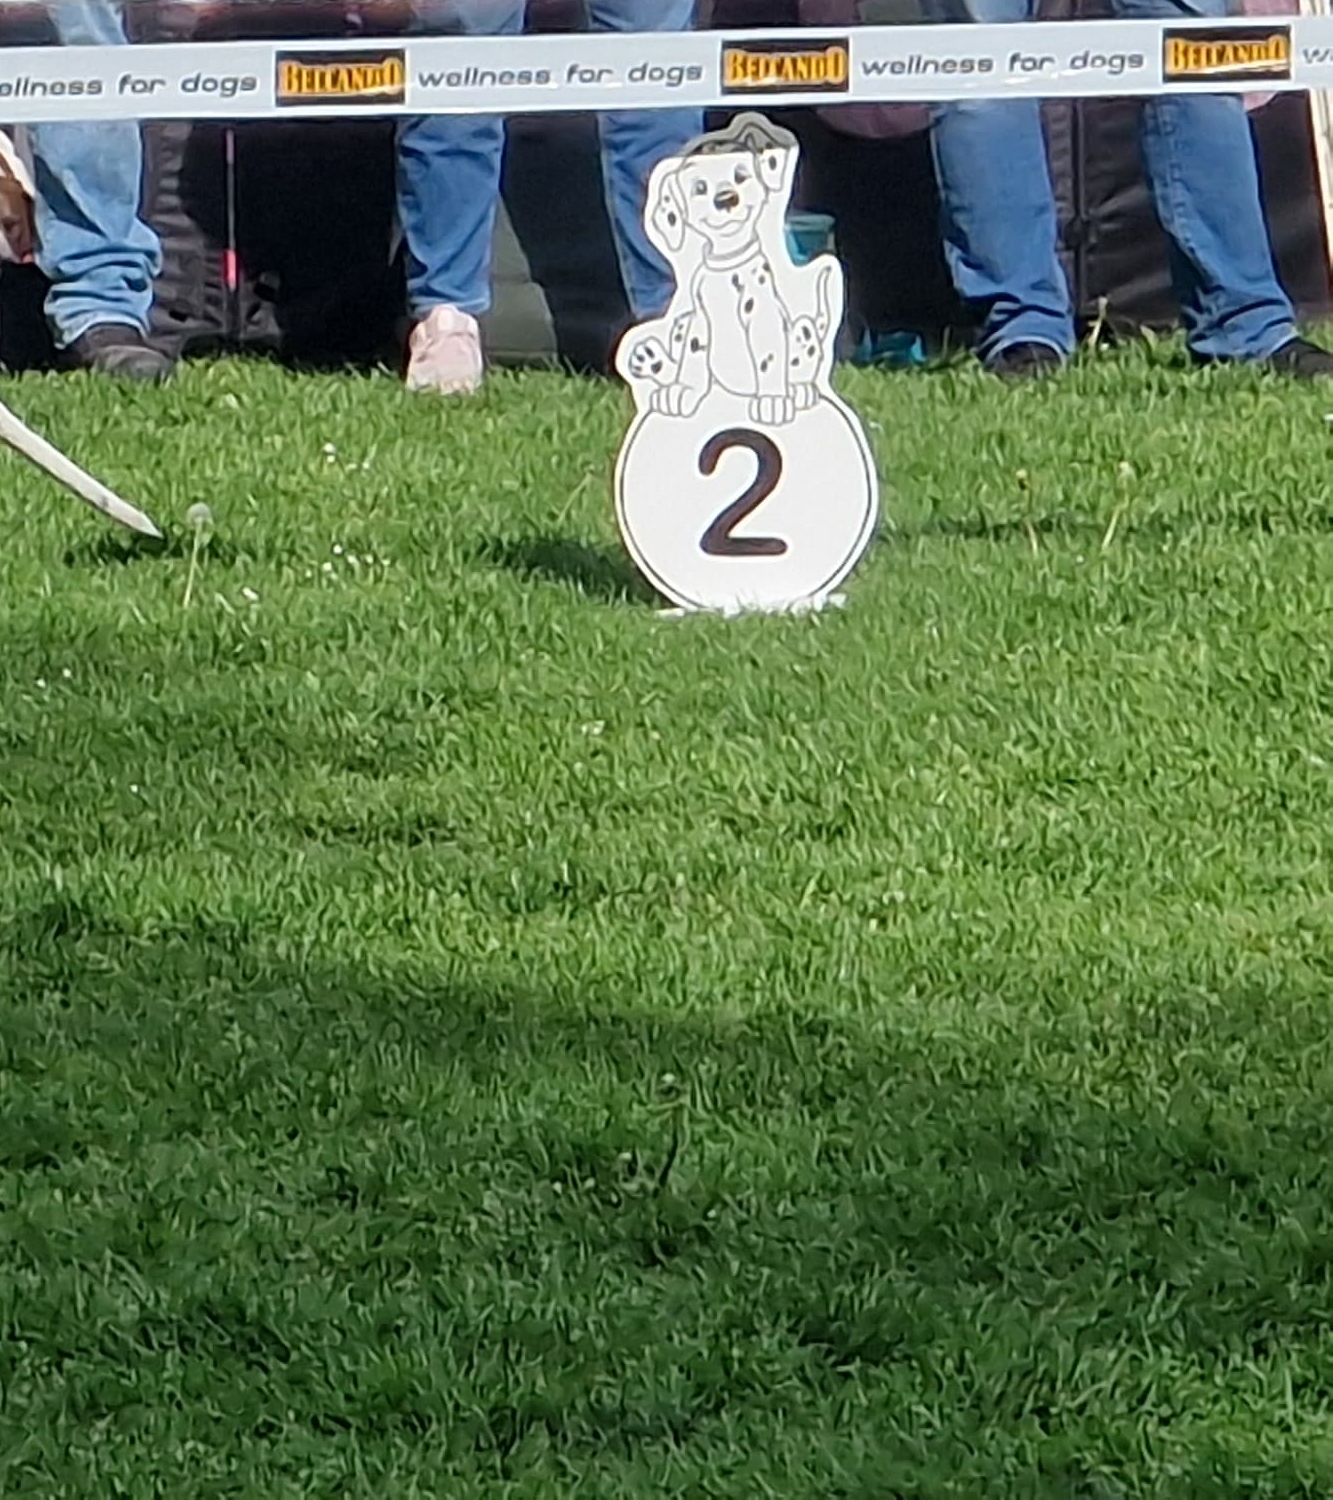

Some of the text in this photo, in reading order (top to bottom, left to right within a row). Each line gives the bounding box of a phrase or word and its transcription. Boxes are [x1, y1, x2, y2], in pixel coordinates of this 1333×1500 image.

[118, 72, 167, 95] for
[180, 70, 259, 97] dogs
[278, 56, 404, 98] BELCANDO
[417, 63, 552, 88] wellness
[565, 62, 615, 85] for
[627, 60, 704, 86] dogs
[723, 46, 849, 86] BELCANDO
[860, 53, 994, 77] wellness
[1007, 51, 1056, 73] for
[1069, 48, 1146, 73] dogs
[1164, 33, 1290, 73] BELCANDO
[699, 428, 789, 555] 2
